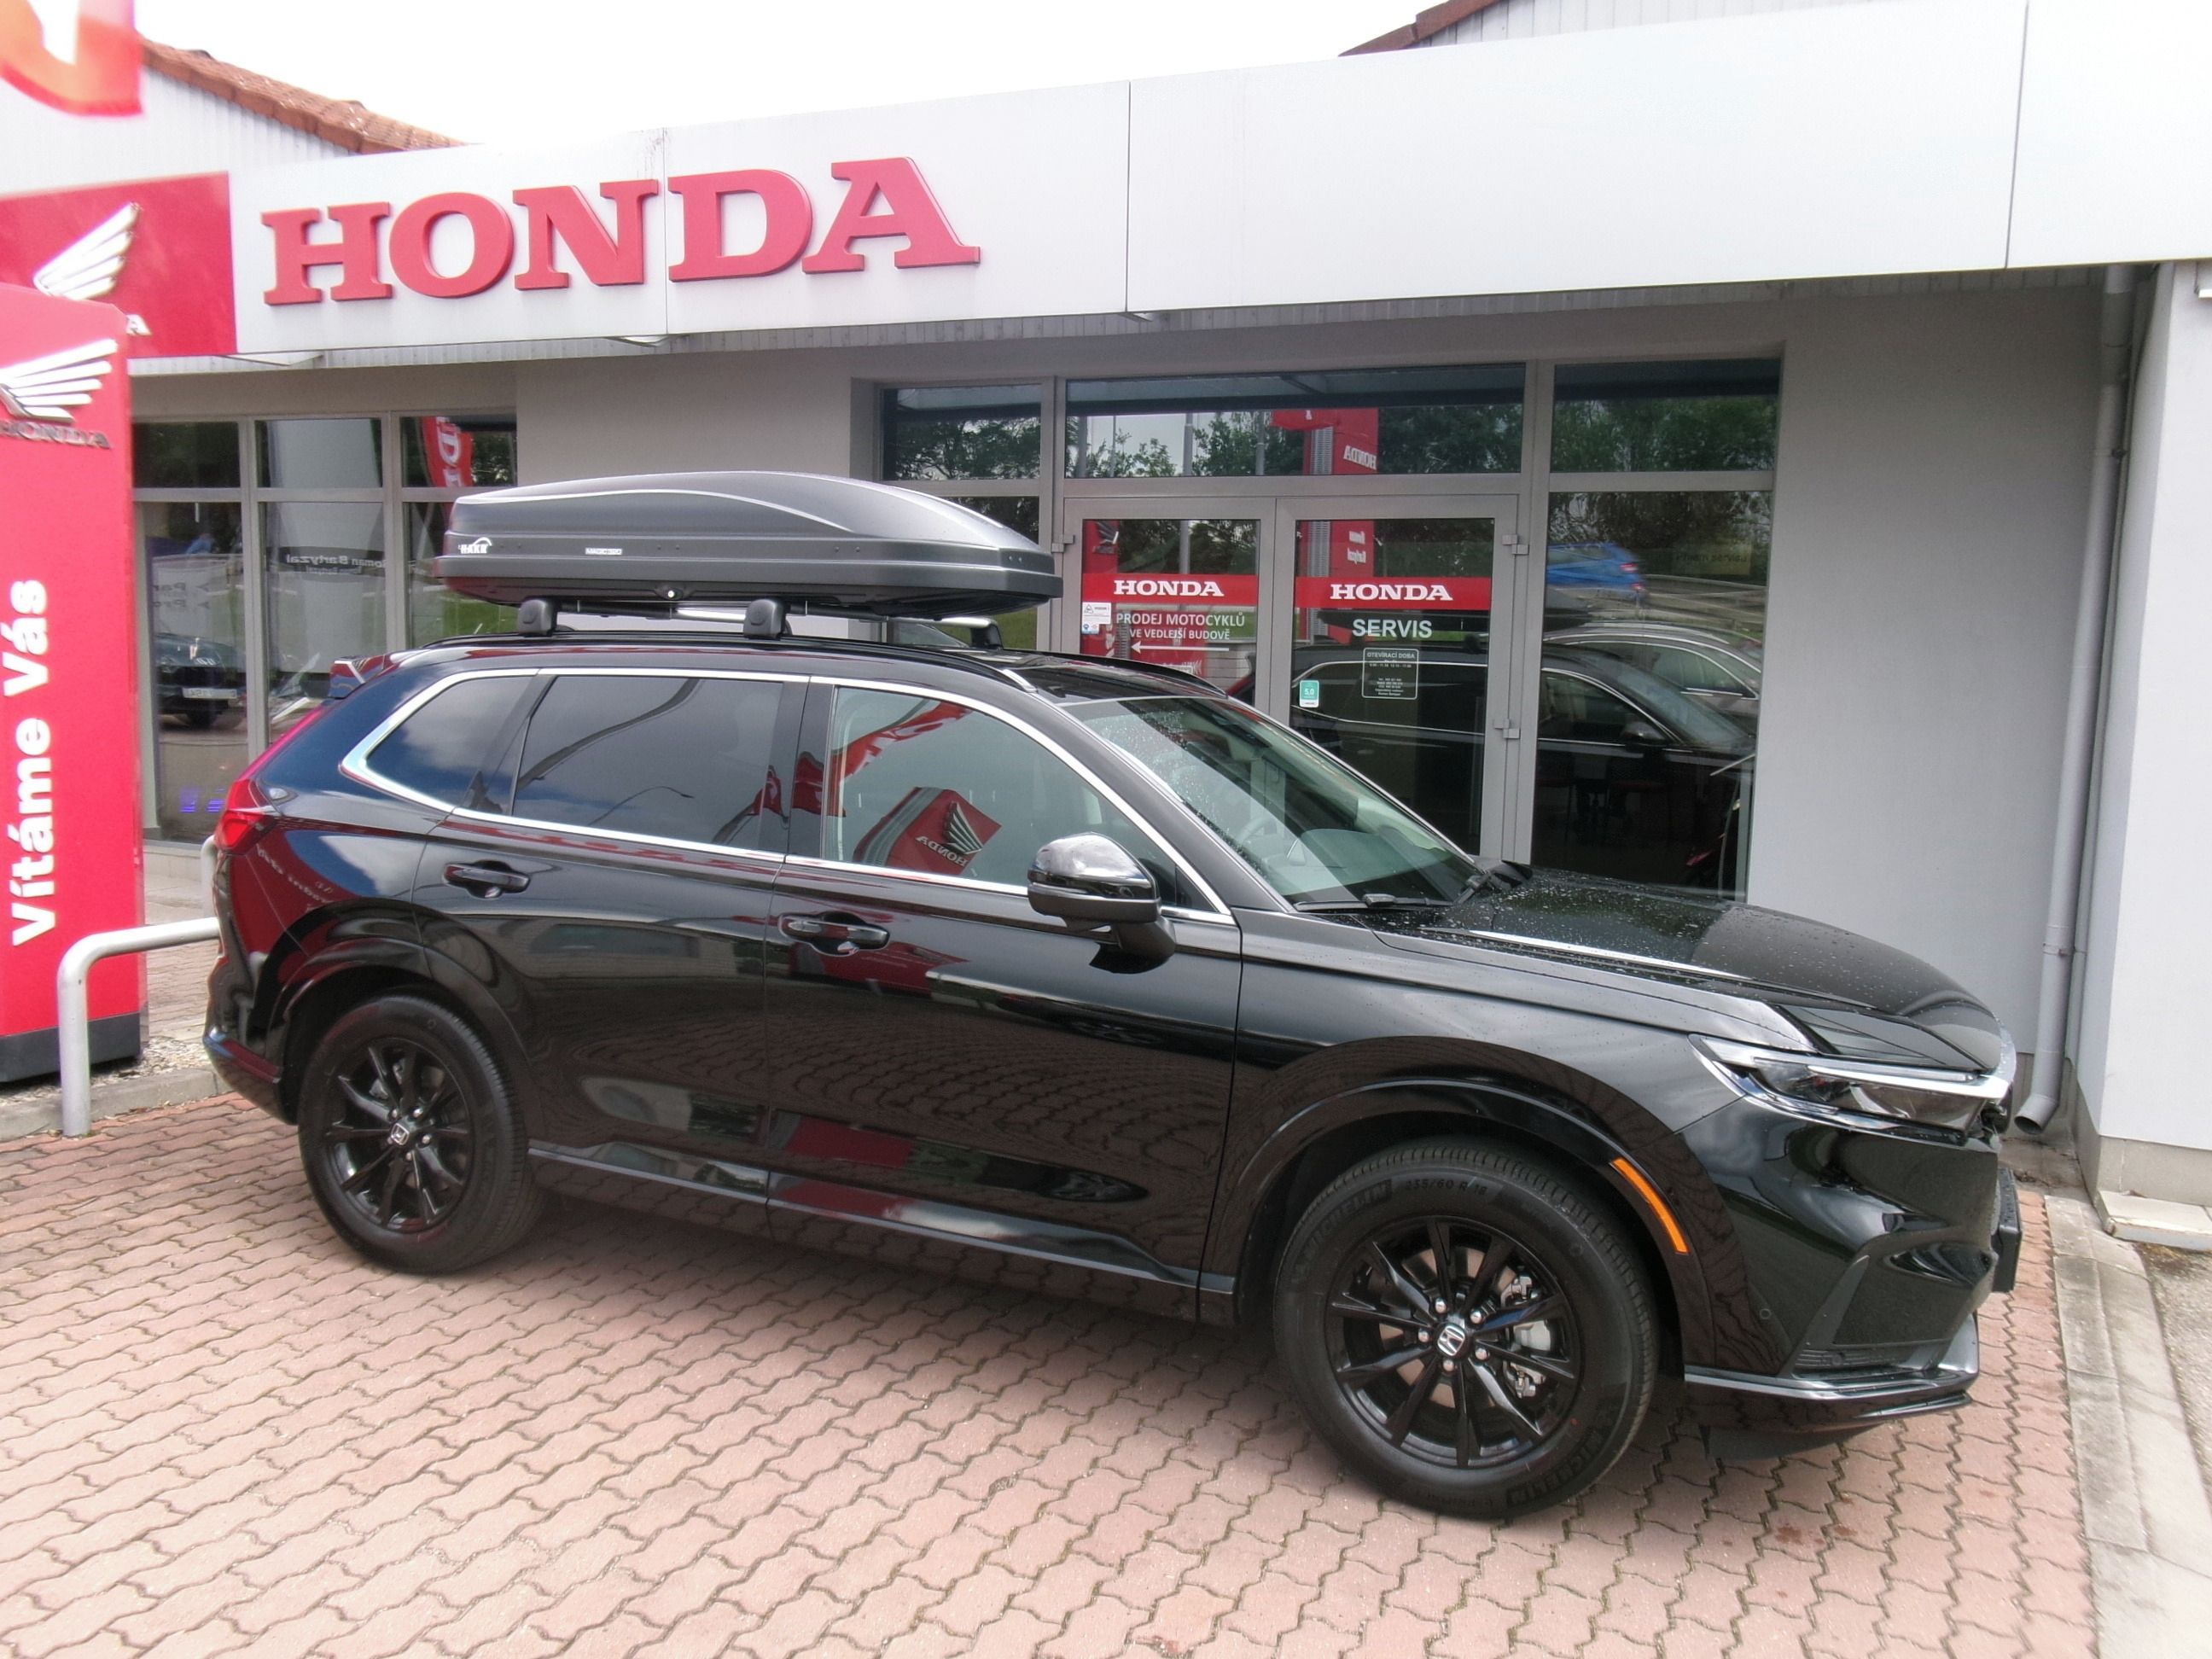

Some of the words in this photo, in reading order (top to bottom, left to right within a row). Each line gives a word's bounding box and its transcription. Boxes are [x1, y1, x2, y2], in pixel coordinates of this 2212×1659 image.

[261, 156, 981, 306] HONDA
[1114, 580, 1225, 597] HONDA
[1330, 584, 1453, 601] HONDA
[1116, 613, 1161, 626] PRODEJ
[1167, 612, 1245, 626] MOTOCYKLŮ
[1130, 629, 1141, 637] VE
[1144, 628, 1185, 639] VEDLEJŠÍ
[1190, 629, 1230, 640] BUDOVĚ
[1353, 619, 1432, 638] SERVIS
[1, 579, 49, 697] Vás
[8, 718, 55, 946] Vítáme
